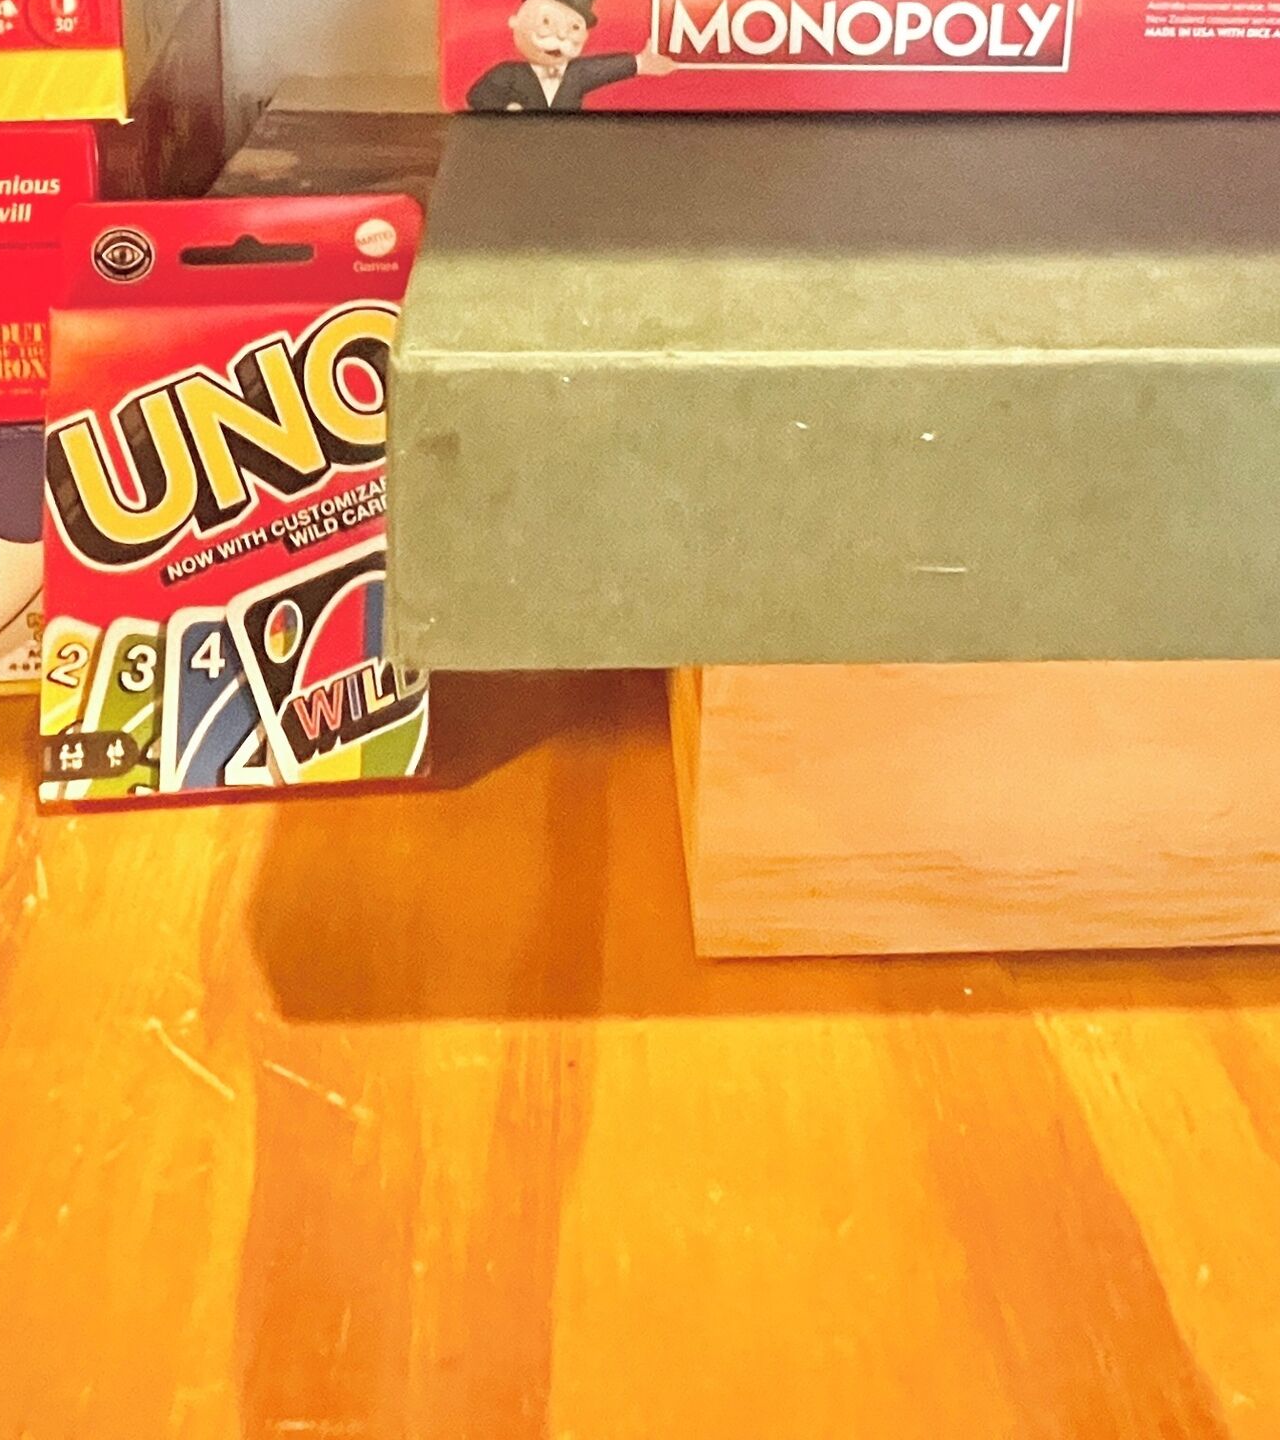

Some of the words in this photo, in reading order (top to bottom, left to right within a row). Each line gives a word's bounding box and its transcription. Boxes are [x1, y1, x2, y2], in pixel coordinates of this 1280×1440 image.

[1143, 27, 1177, 38] MADE
[1178, 27, 1191, 38] IN
[1192, 27, 1216, 38] USA
[1216, 27, 1246, 39] WITH
[48, 306, 388, 558] UNO
[166, 547, 215, 582] NOW
[216, 527, 269, 561] WITH
[289, 517, 339, 549] WILD
[48, 642, 90, 689] 2
[118, 644, 158, 692] 3
[190, 631, 226, 679] 4
